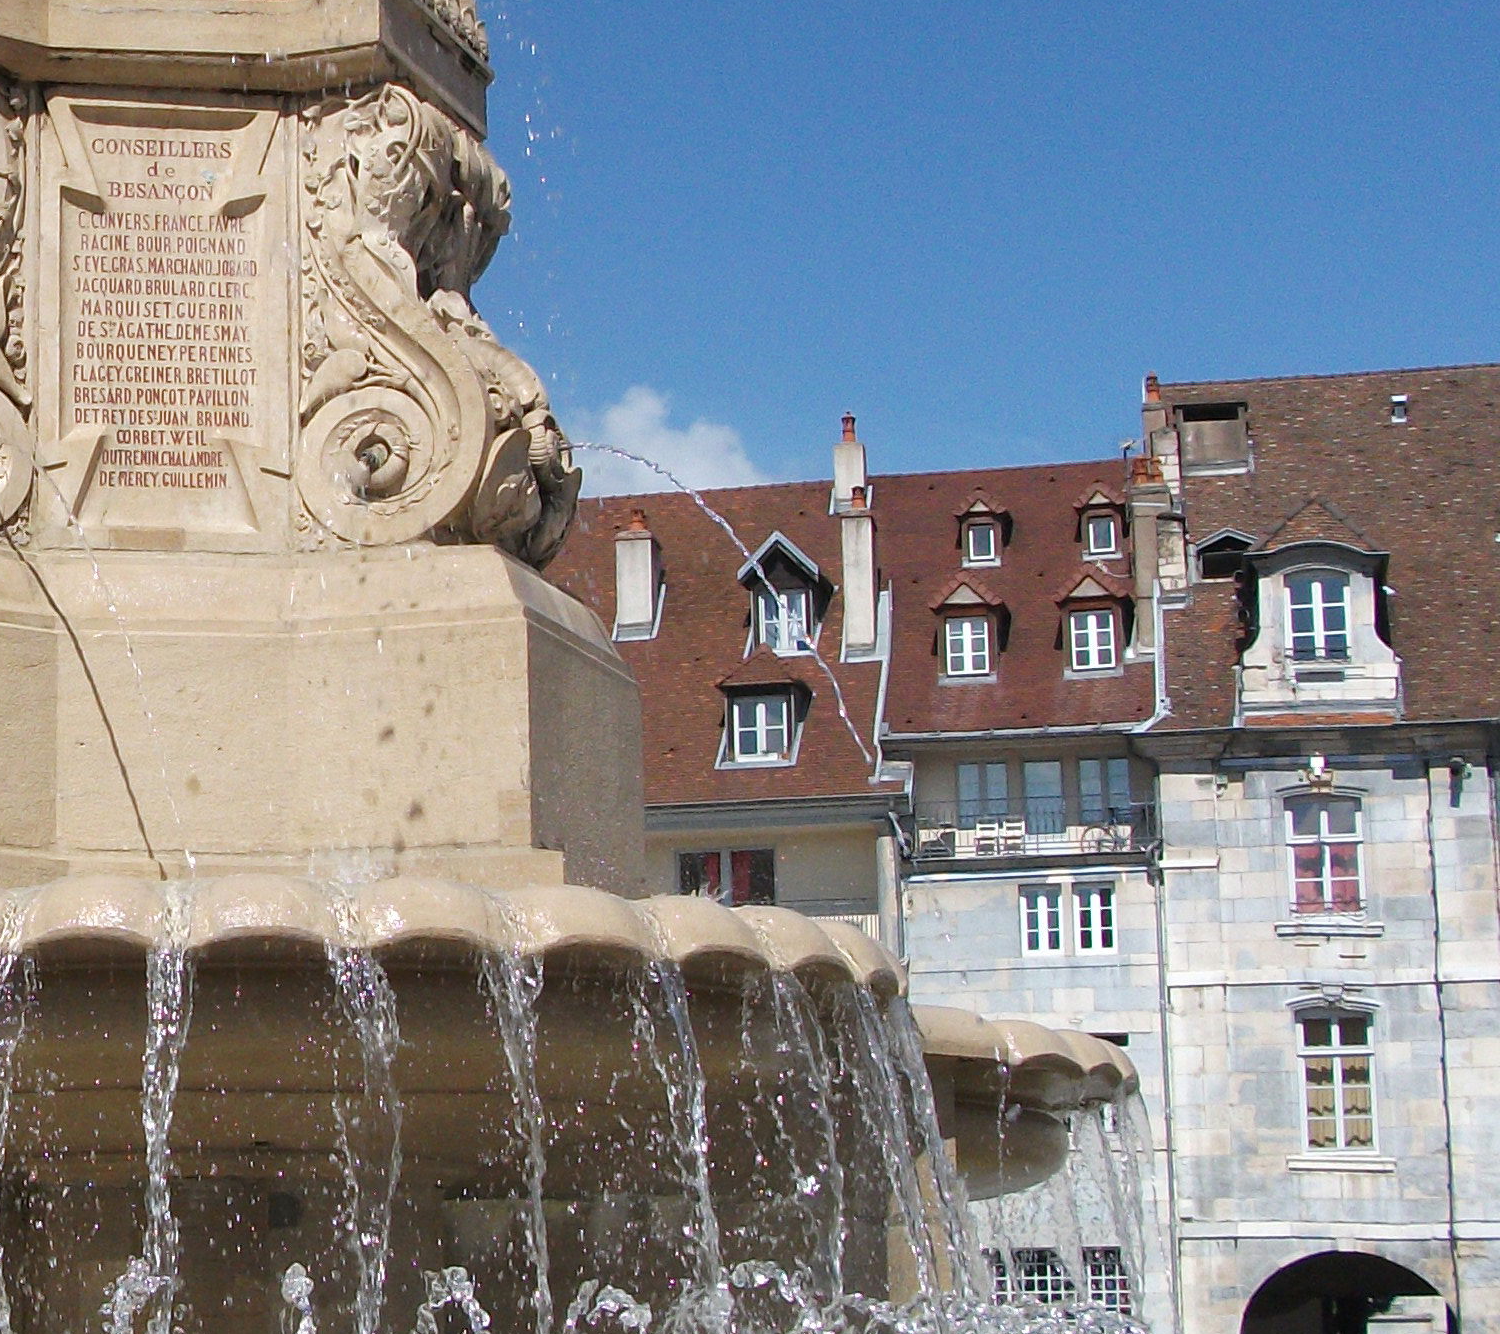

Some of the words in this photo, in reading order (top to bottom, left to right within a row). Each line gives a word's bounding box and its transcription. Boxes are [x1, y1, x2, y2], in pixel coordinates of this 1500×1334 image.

[92, 138, 232, 159] CONSEILLERS
[147, 161, 175, 177] de
[107, 181, 213, 205] BESANÇON
[78, 320, 96, 338] DE
[100, 471, 115, 487] DE
